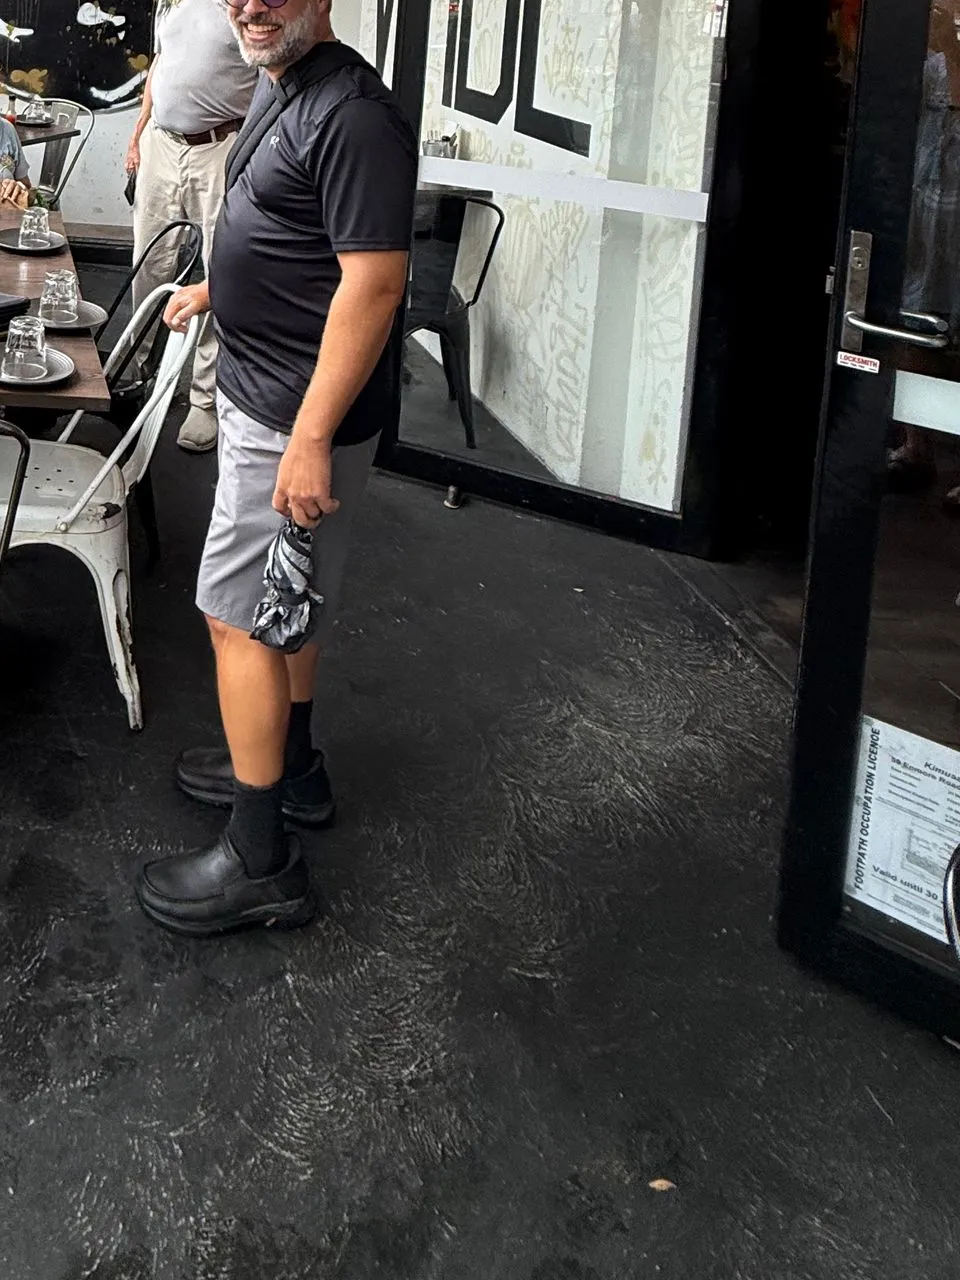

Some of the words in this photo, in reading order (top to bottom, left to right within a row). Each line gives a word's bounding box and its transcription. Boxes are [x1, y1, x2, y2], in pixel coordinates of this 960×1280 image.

[840, 354, 878, 368] LOCKSMITH
[867, 727, 881, 771] LICENCE
[860, 771, 876, 837] OCCUPATION
[854, 837, 868, 891] FOOTPATH
[872, 865, 898, 881] Valid
[900, 879, 923, 894] until
